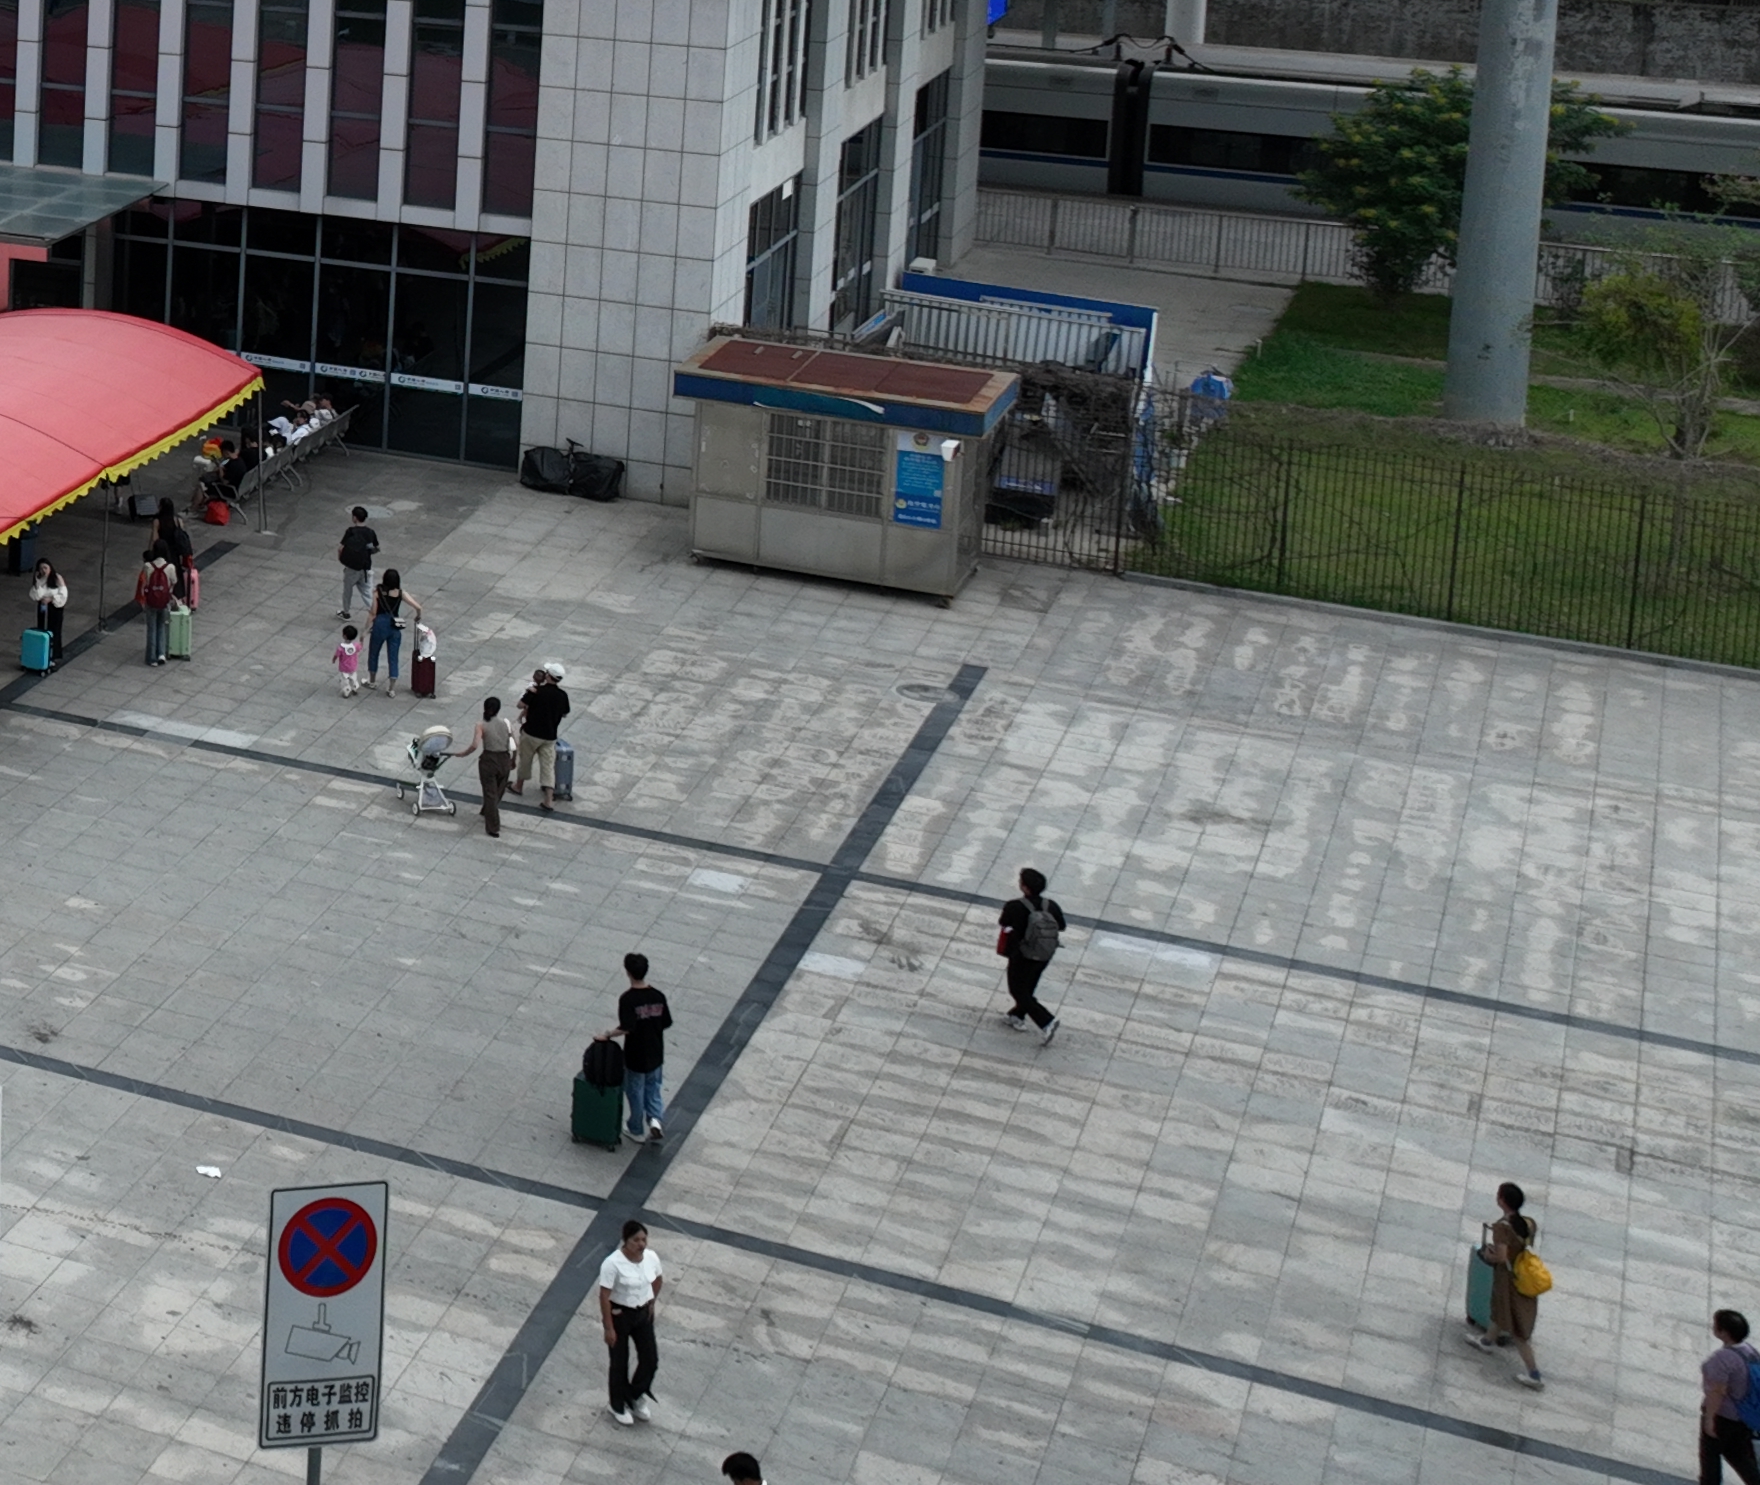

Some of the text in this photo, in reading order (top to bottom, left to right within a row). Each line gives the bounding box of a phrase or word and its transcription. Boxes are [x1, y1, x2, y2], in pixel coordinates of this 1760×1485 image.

[272, 1381, 370, 1410] 前方电子监控
[276, 1407, 363, 1435] 违停抓拍
